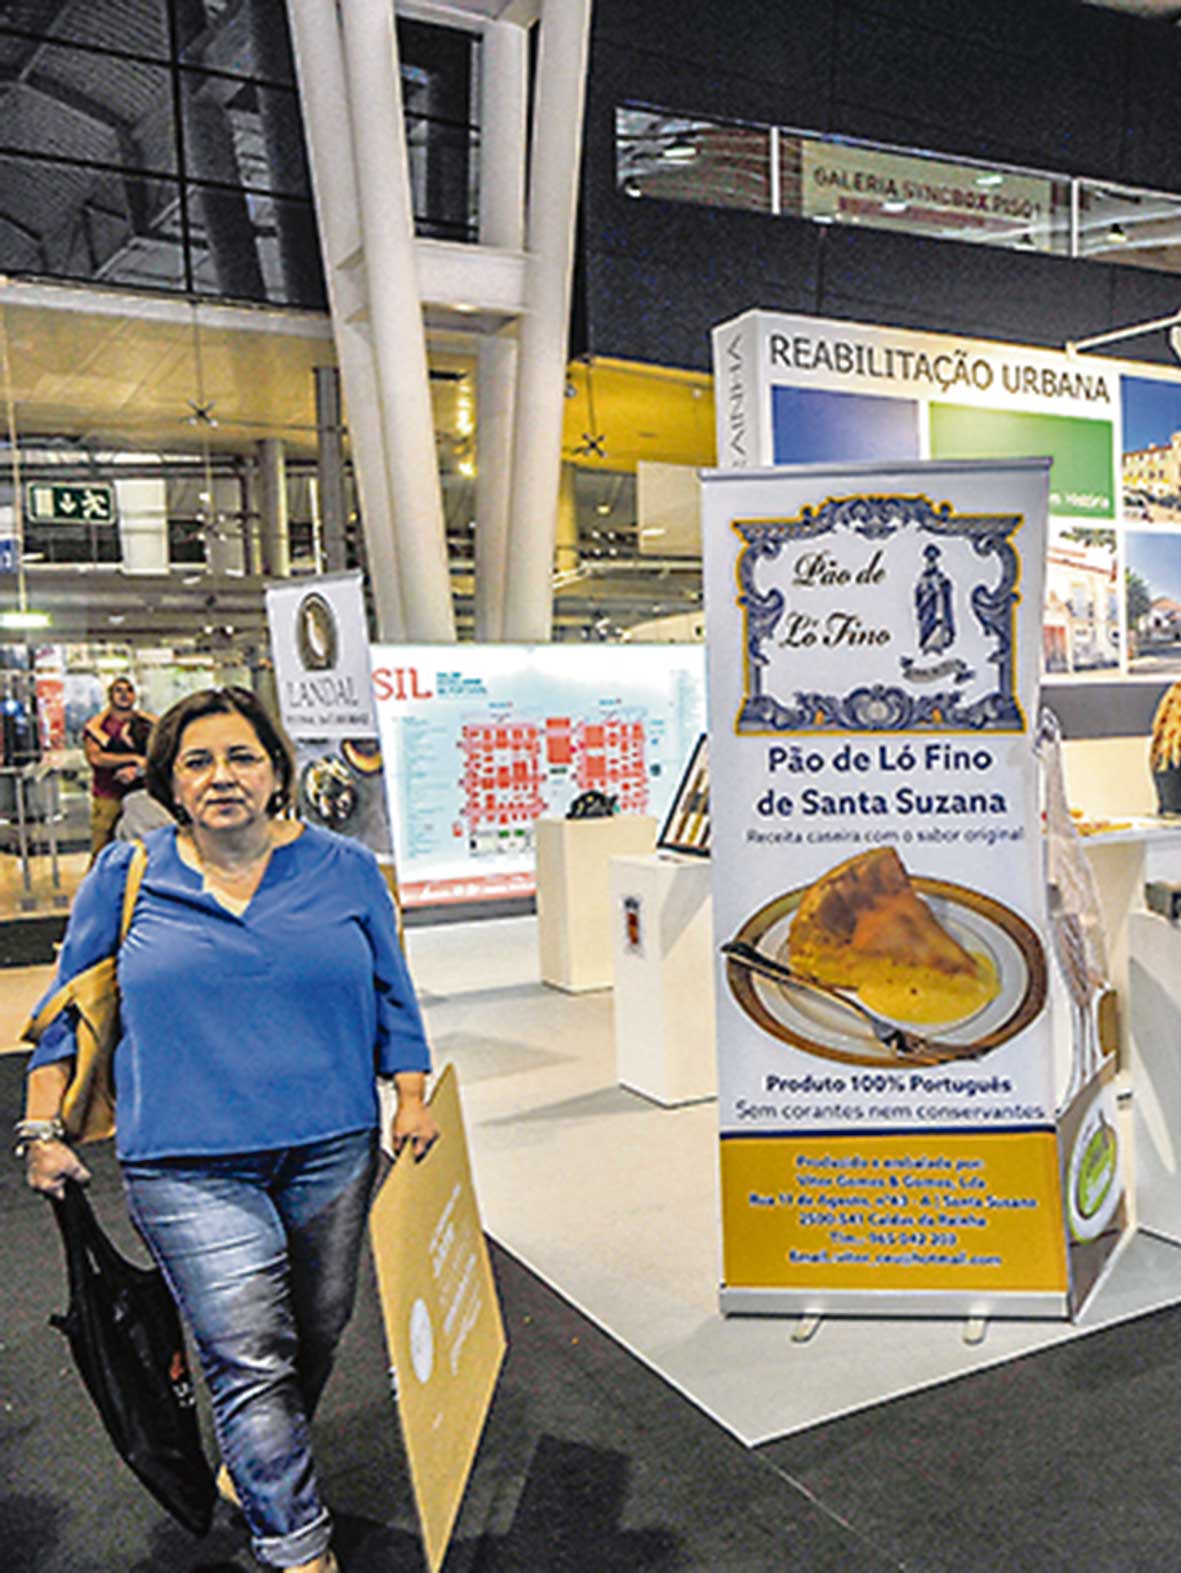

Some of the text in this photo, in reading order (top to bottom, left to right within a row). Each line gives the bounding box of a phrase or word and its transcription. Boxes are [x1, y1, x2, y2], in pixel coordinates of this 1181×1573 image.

[813, 166, 898, 197] GALERIA
[769, 333, 1111, 404] REABILITAÇÃO URBANA
[792, 549, 886, 587] Pão de
[822, 612, 891, 649] Fino
[370, 666, 433, 700] SIL
[768, 742, 994, 775] Pão de Ló Fino
[756, 787, 1008, 817] de Santa Suzana
[746, 829, 803, 845] Receita
[863, 830, 899, 845] com
[902, 831, 914, 844] o
[916, 827, 961, 844] sabor
[962, 826, 1025, 846] original
[765, 1073, 1013, 1096] Produto 100% Português
[735, 1099, 1046, 1120] Sem corantes nem conservantes
